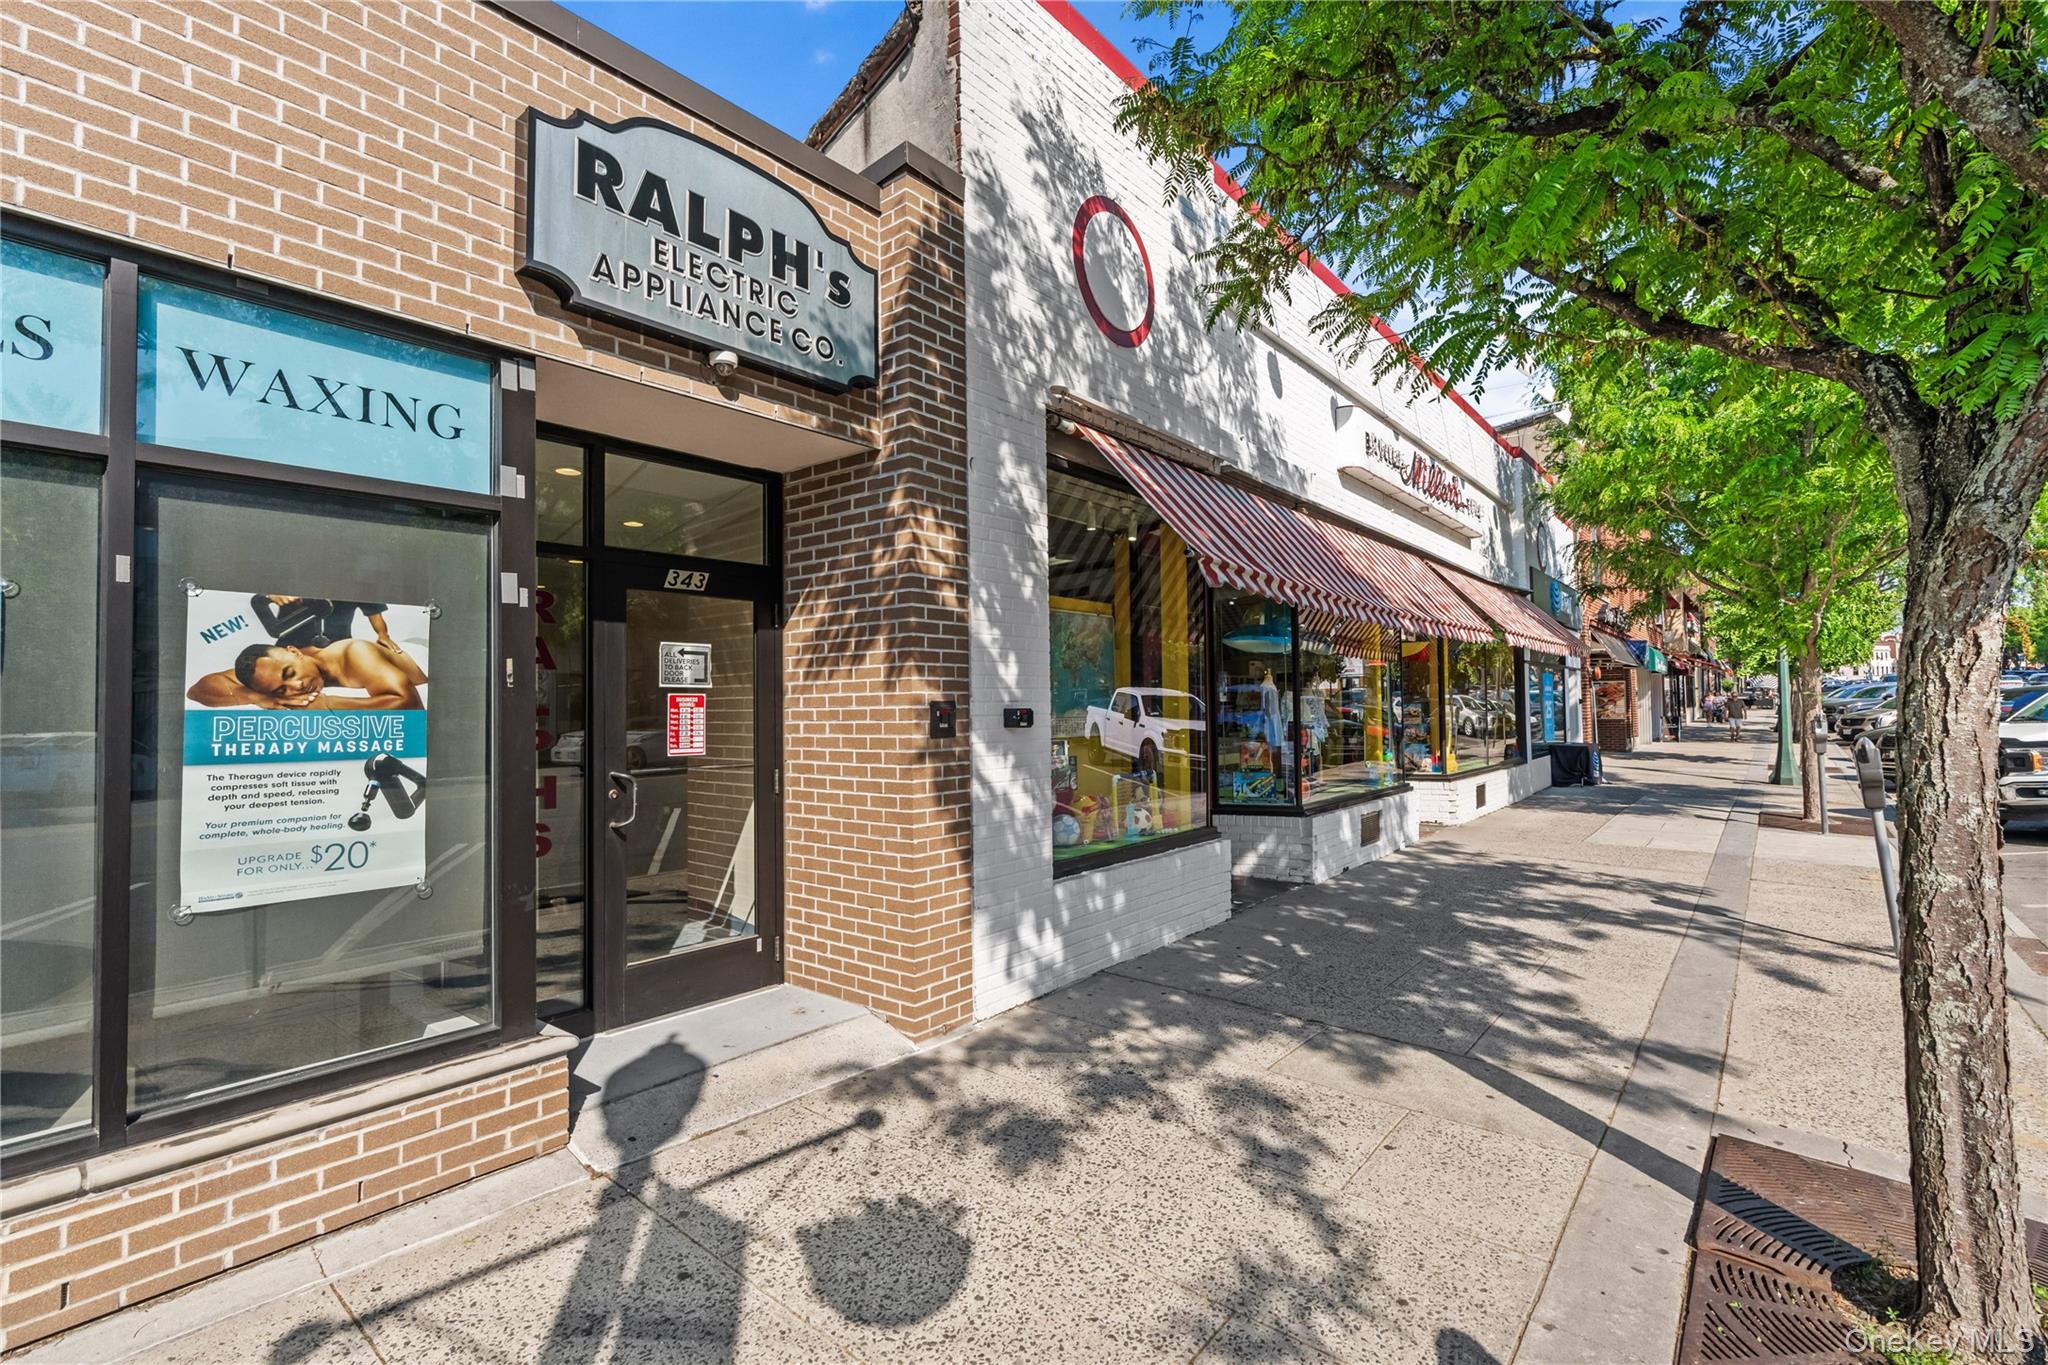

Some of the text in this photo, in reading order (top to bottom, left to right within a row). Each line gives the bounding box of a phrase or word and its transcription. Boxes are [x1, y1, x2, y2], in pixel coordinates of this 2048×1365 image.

[575, 136, 853, 307] RALPH'S
[651, 236, 800, 318] ELECTRIC
[590, 252, 845, 367] APPLIANCE CO.
[0, 315, 54, 361] S
[175, 346, 466, 440] WAXING
[667, 570, 706, 588] 343
[200, 615, 249, 644] NEW!
[212, 715, 405, 742] PERCUSSIVE
[211, 739, 405, 757] THERAPY MASSAGE
[206, 769, 342, 783] The Theragun device rapidly
[210, 783, 269, 793] compresses
[291, 780, 317, 788] tissue
[319, 778, 338, 786] with
[207, 788, 340, 802] depth and speed, releasing
[224, 798, 326, 812] your deepest tension.
[205, 821, 228, 829] Your
[230, 818, 274, 829] premium
[276, 814, 327, 824] companion
[199, 822, 346, 840] complete, whole-body healing.
[237, 852, 302, 866] UPGRADE
[236, 866, 264, 877] FOR
